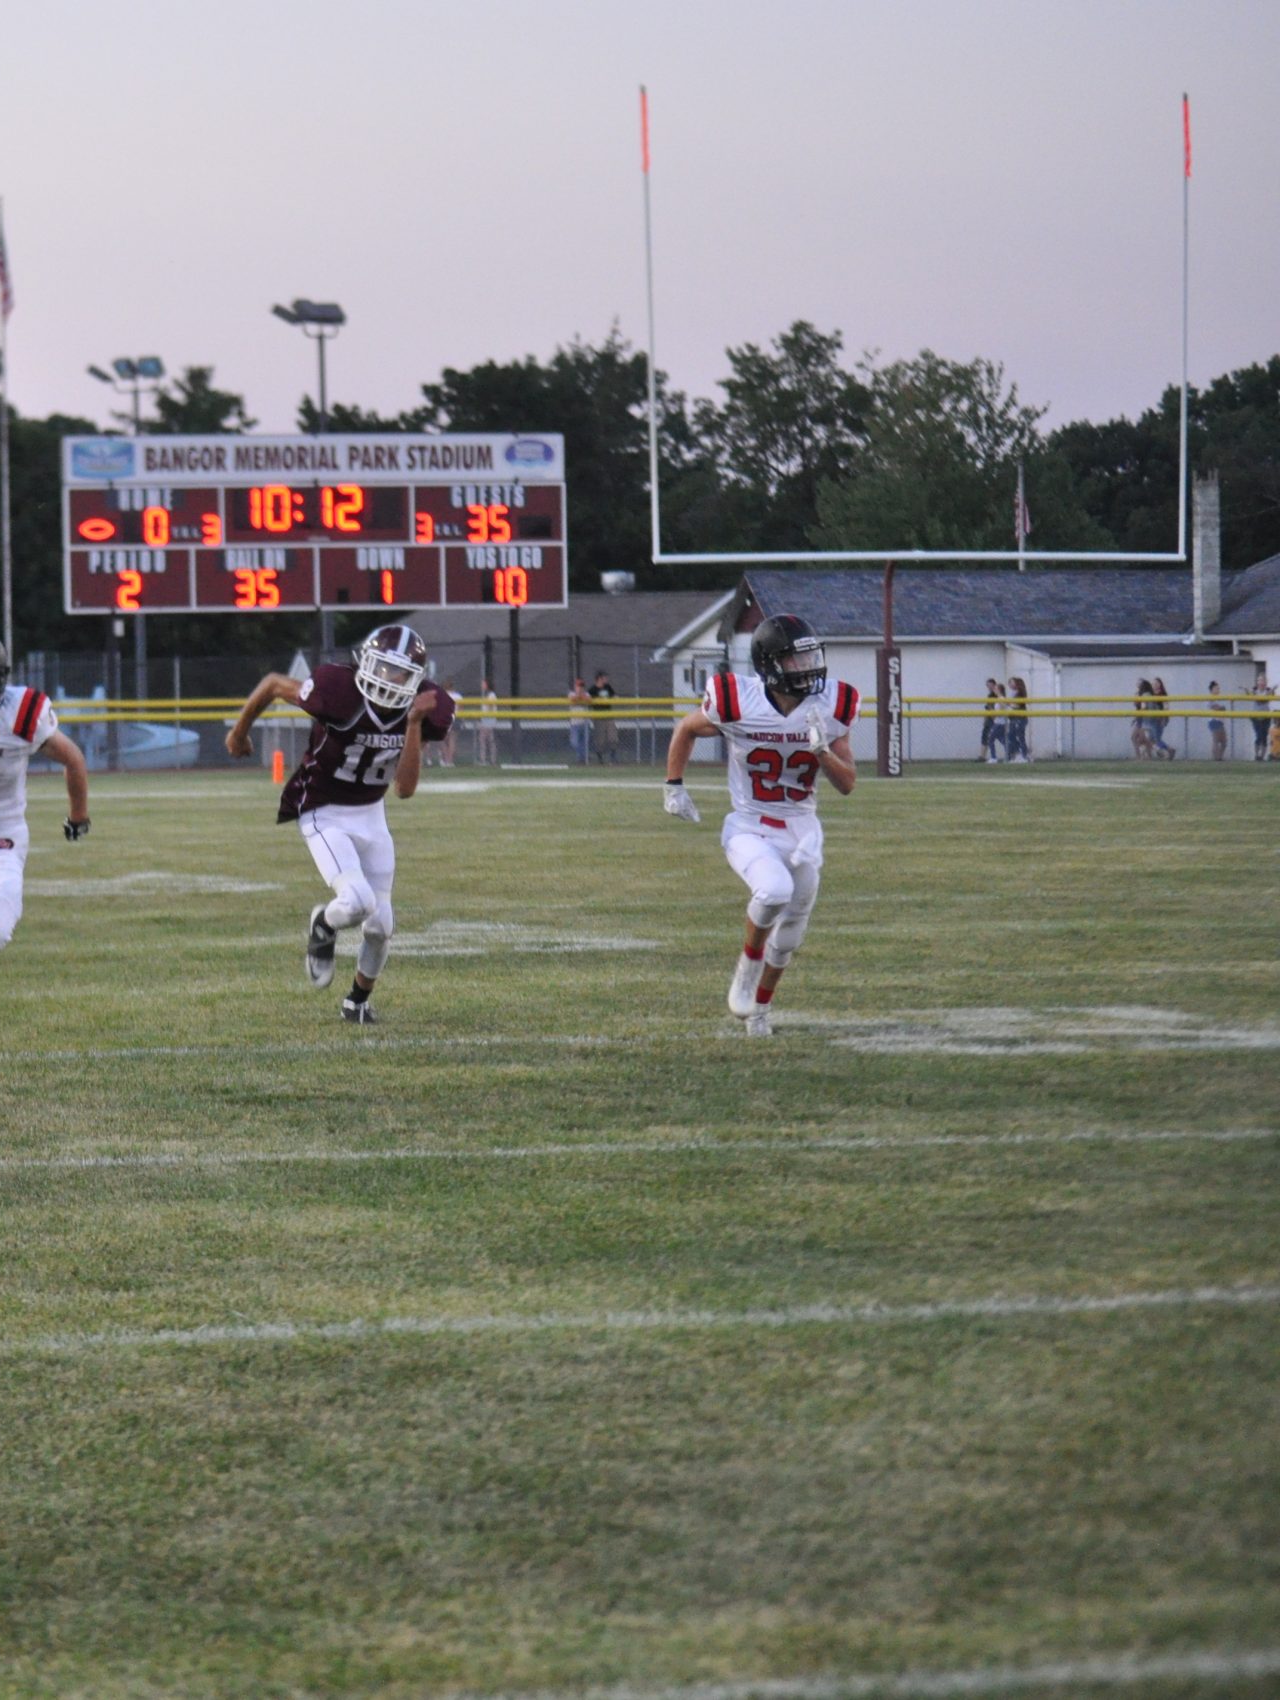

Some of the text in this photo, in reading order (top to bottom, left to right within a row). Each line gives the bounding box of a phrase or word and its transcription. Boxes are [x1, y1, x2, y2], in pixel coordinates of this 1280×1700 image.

[144, 446, 227, 472] BANGOR
[234, 446, 339, 471] MEMORIAL
[348, 445, 400, 470] PARK
[407, 445, 494, 470] STADIUM
[249, 483, 364, 532] 10:12
[451, 485, 525, 508] GUESTS
[143, 506, 169, 547] 0
[201, 512, 222, 547] 3
[415, 511, 434, 544] 3
[467, 504, 512, 544] 35
[88, 550, 167, 574] PERIOD
[355, 547, 405, 571] DOWN
[116, 569, 143, 611] 2
[234, 568, 280, 608] 35
[381, 569, 393, 604] 1
[494, 566, 528, 606] 10
[888, 656, 900, 775] SLATERS
[786, 732, 810, 743] VALL
[746, 747, 820, 802] 23
